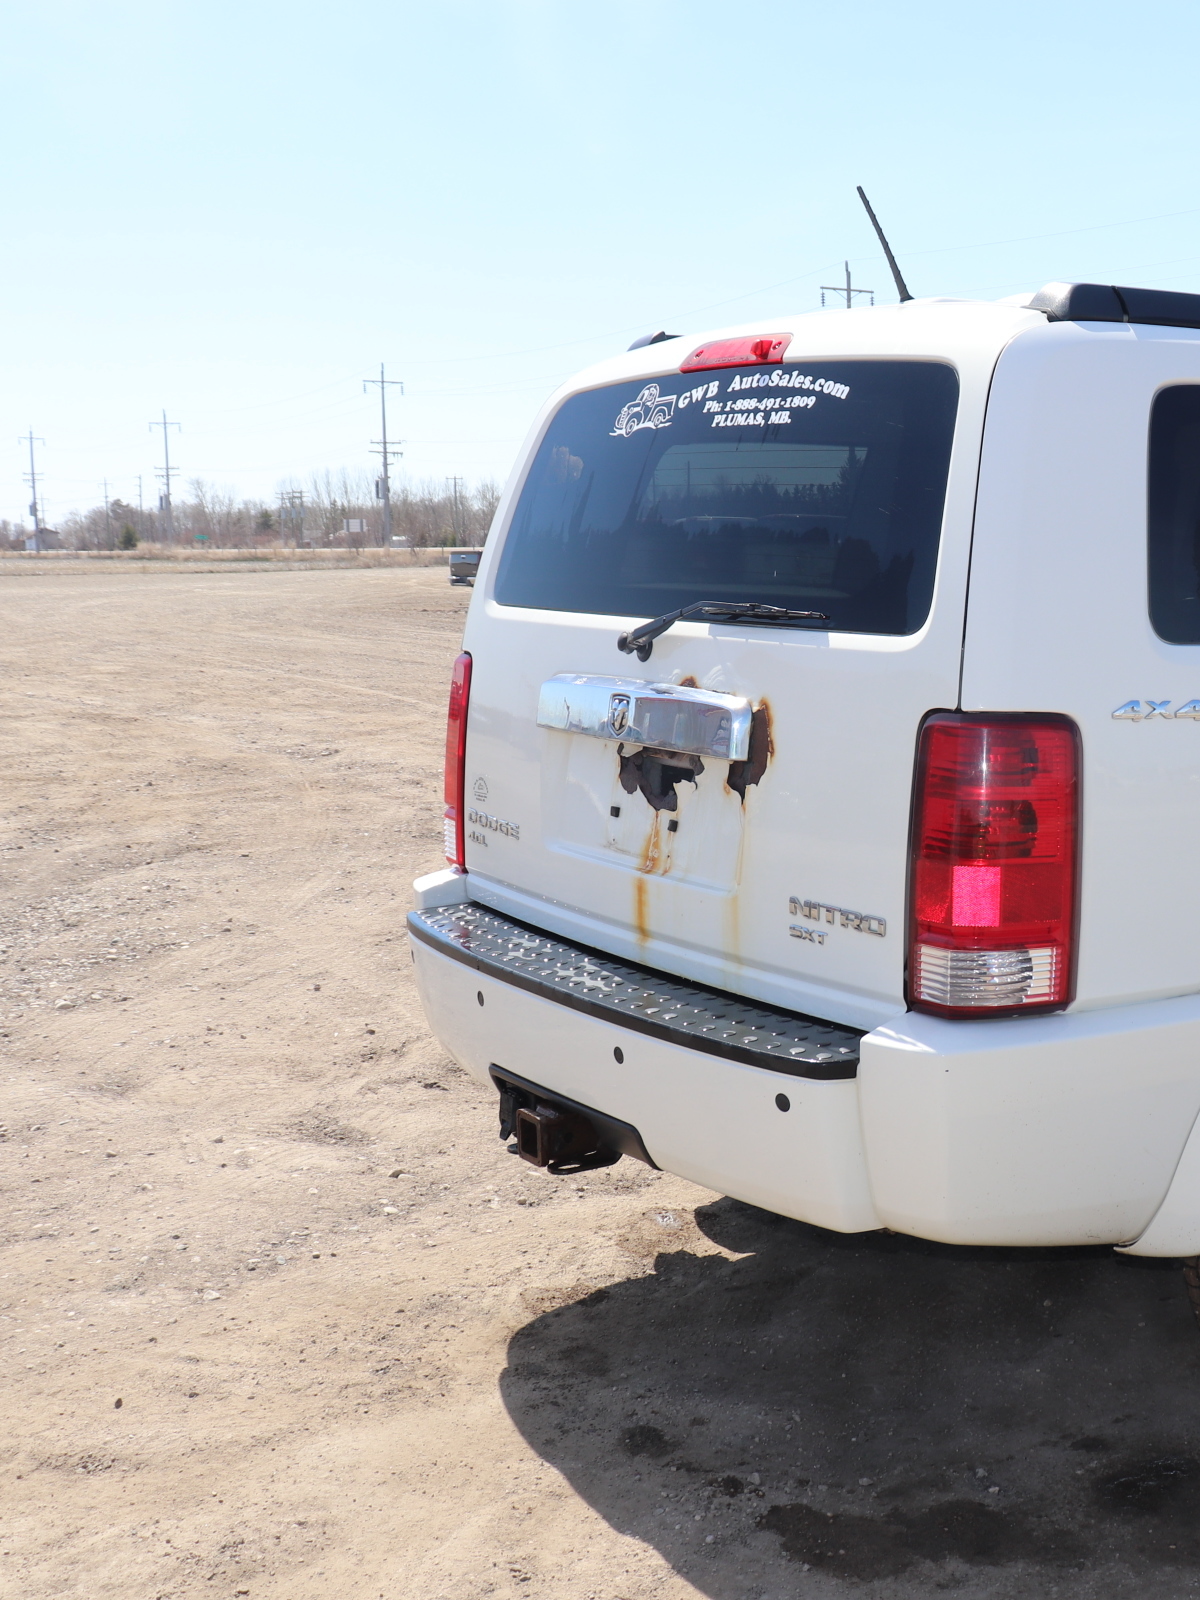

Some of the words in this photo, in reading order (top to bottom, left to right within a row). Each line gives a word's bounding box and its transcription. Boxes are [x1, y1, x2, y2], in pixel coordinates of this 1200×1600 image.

[678, 380, 720, 409] GWB
[727, 369, 850, 400] AutoSales.com
[702, 401, 723, 413] Ph:
[724, 396, 816, 412] 1-888-491-1809
[711, 412, 766, 428] PLUMAS,
[768, 411, 792, 425] MB.
[468, 807, 520, 841] DODGE
[789, 896, 887, 938] NITRO
[789, 924, 828, 945] SXT
